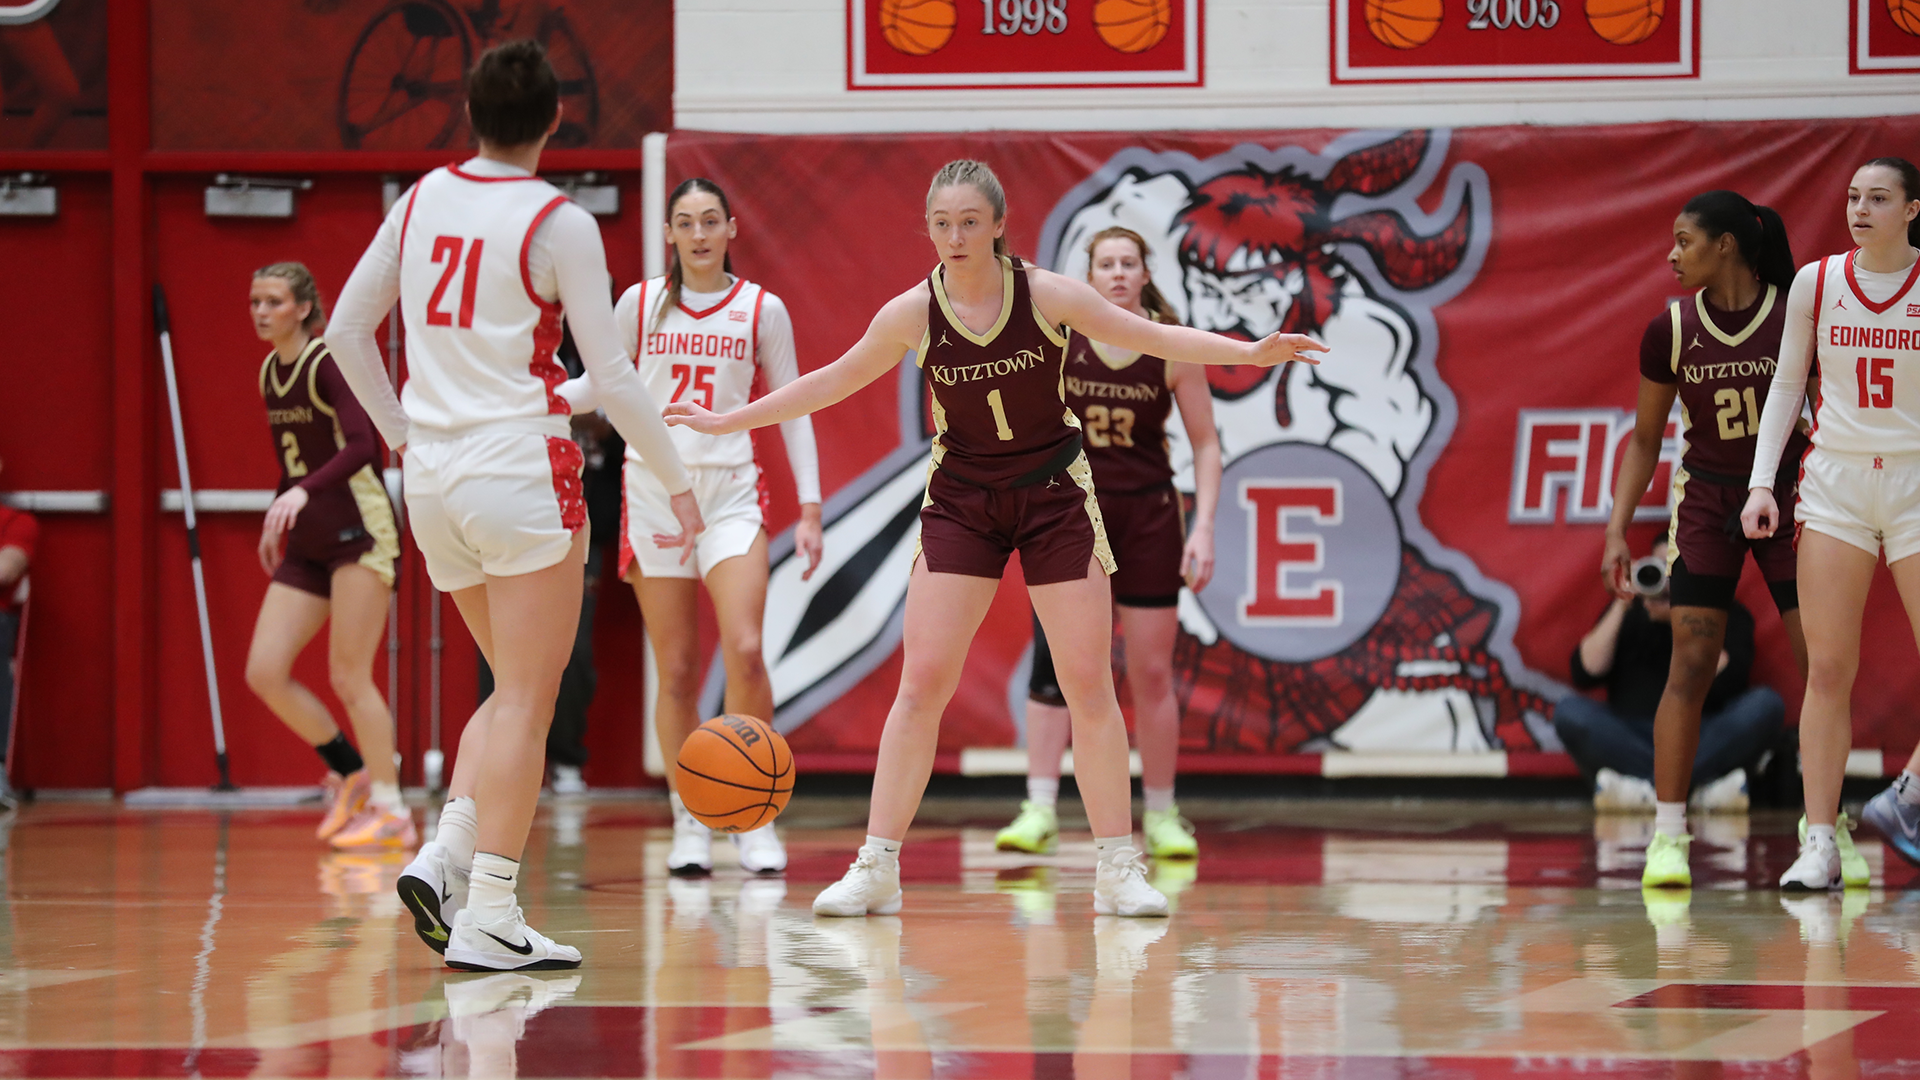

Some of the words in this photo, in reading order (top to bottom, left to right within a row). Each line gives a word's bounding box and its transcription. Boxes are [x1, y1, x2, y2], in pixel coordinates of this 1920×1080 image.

[981, 0, 1068, 35] 1998
[1467, 0, 1560, 29] 2005
[426, 235, 485, 329] 21
[647, 332, 747, 360] EDINBORO
[929, 344, 1045, 386] KUTZTOWN
[669, 363, 716, 412] 25
[1065, 375, 1160, 402] KUTZTOWN
[1855, 356, 1895, 409] 15
[986, 388, 1014, 441] 1
[1085, 404, 1136, 448] 23
[1713, 386, 1760, 440] 21
[281, 430, 309, 478] 2
[1239, 480, 1342, 625] E
